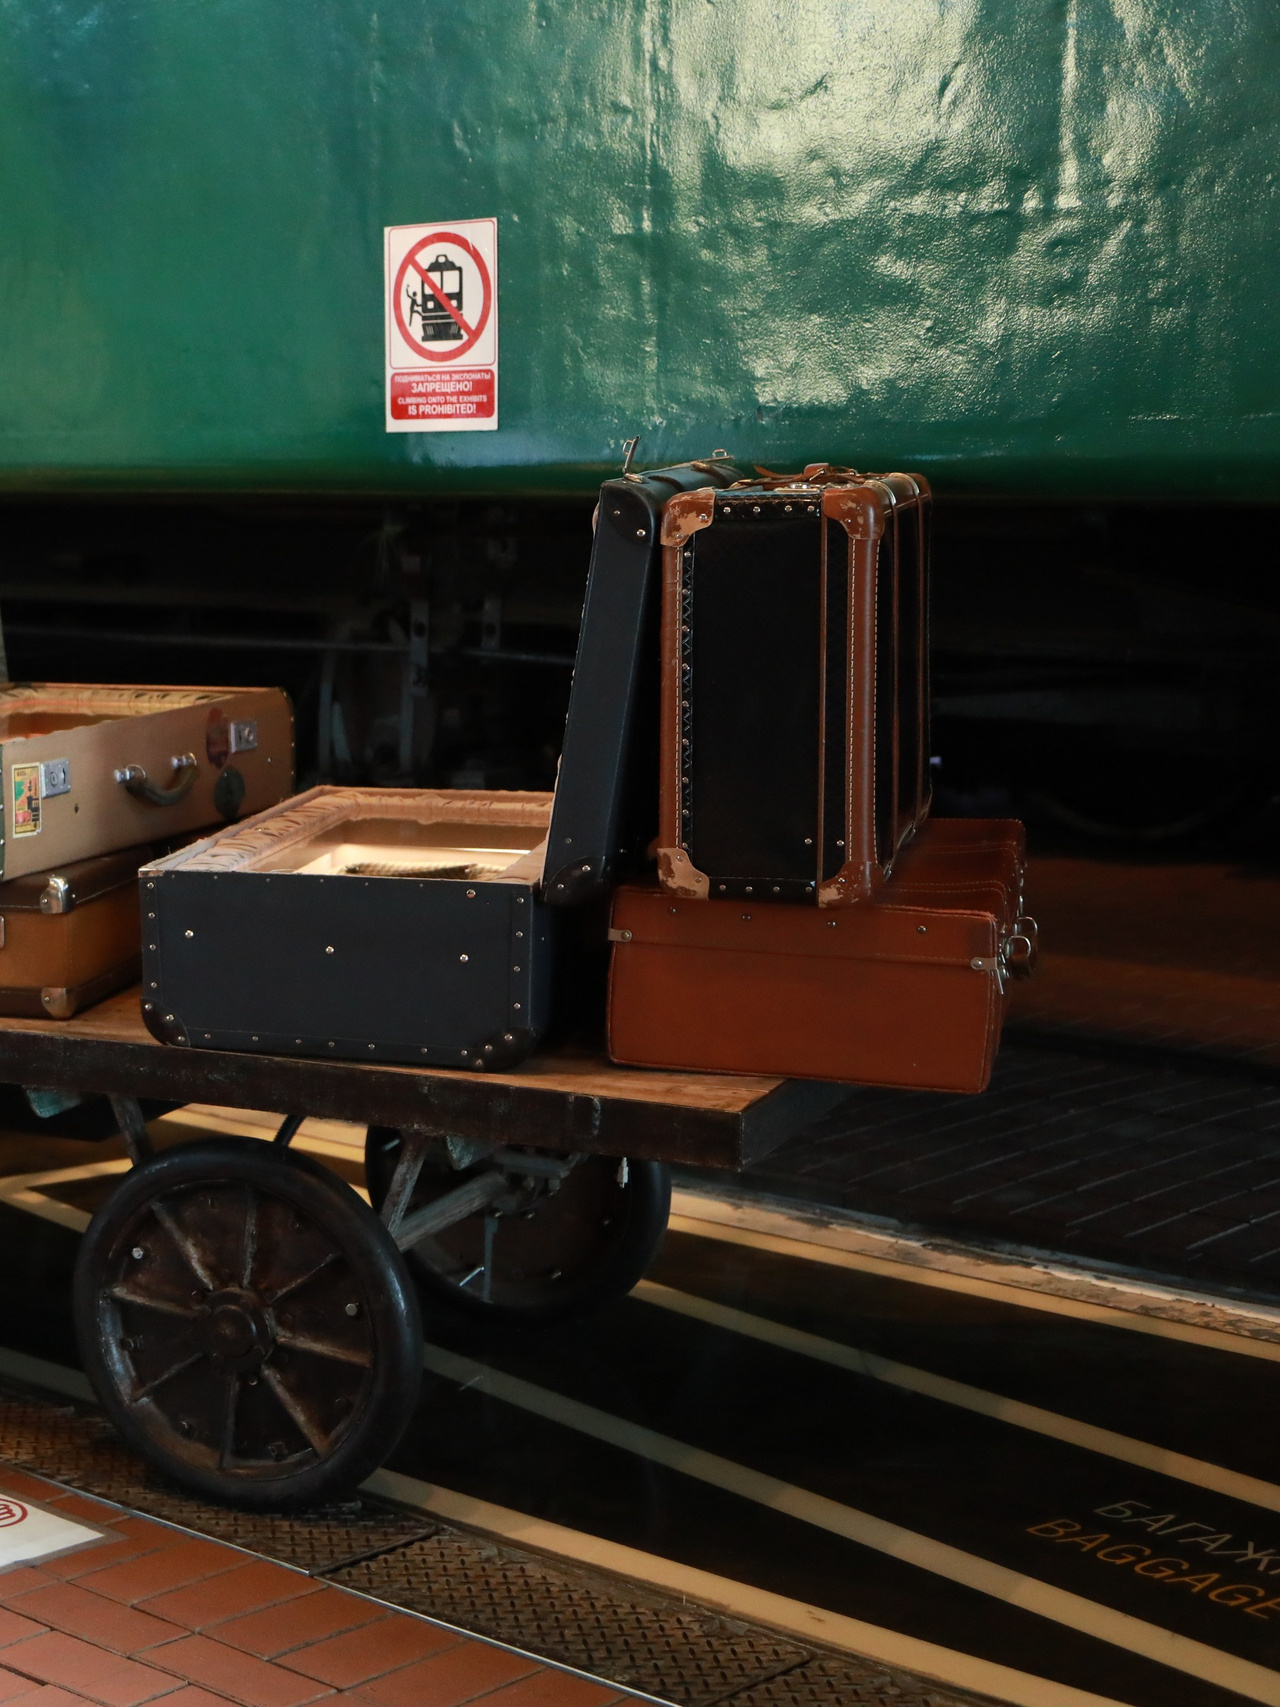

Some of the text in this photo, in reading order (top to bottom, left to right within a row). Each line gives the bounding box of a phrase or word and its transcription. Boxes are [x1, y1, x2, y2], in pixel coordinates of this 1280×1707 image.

[452, 372, 491, 381] ЭКСПОНАТЫ
[411, 381, 473, 393] ЗАПРЕЩЕНО!
[397, 397, 427, 405] CLIMBING
[408, 403, 477, 415] IS PROHIBITED!
[1092, 1499, 1280, 1575] БАГАЖ
[1025, 1518, 1280, 1620] BAGGAGE
